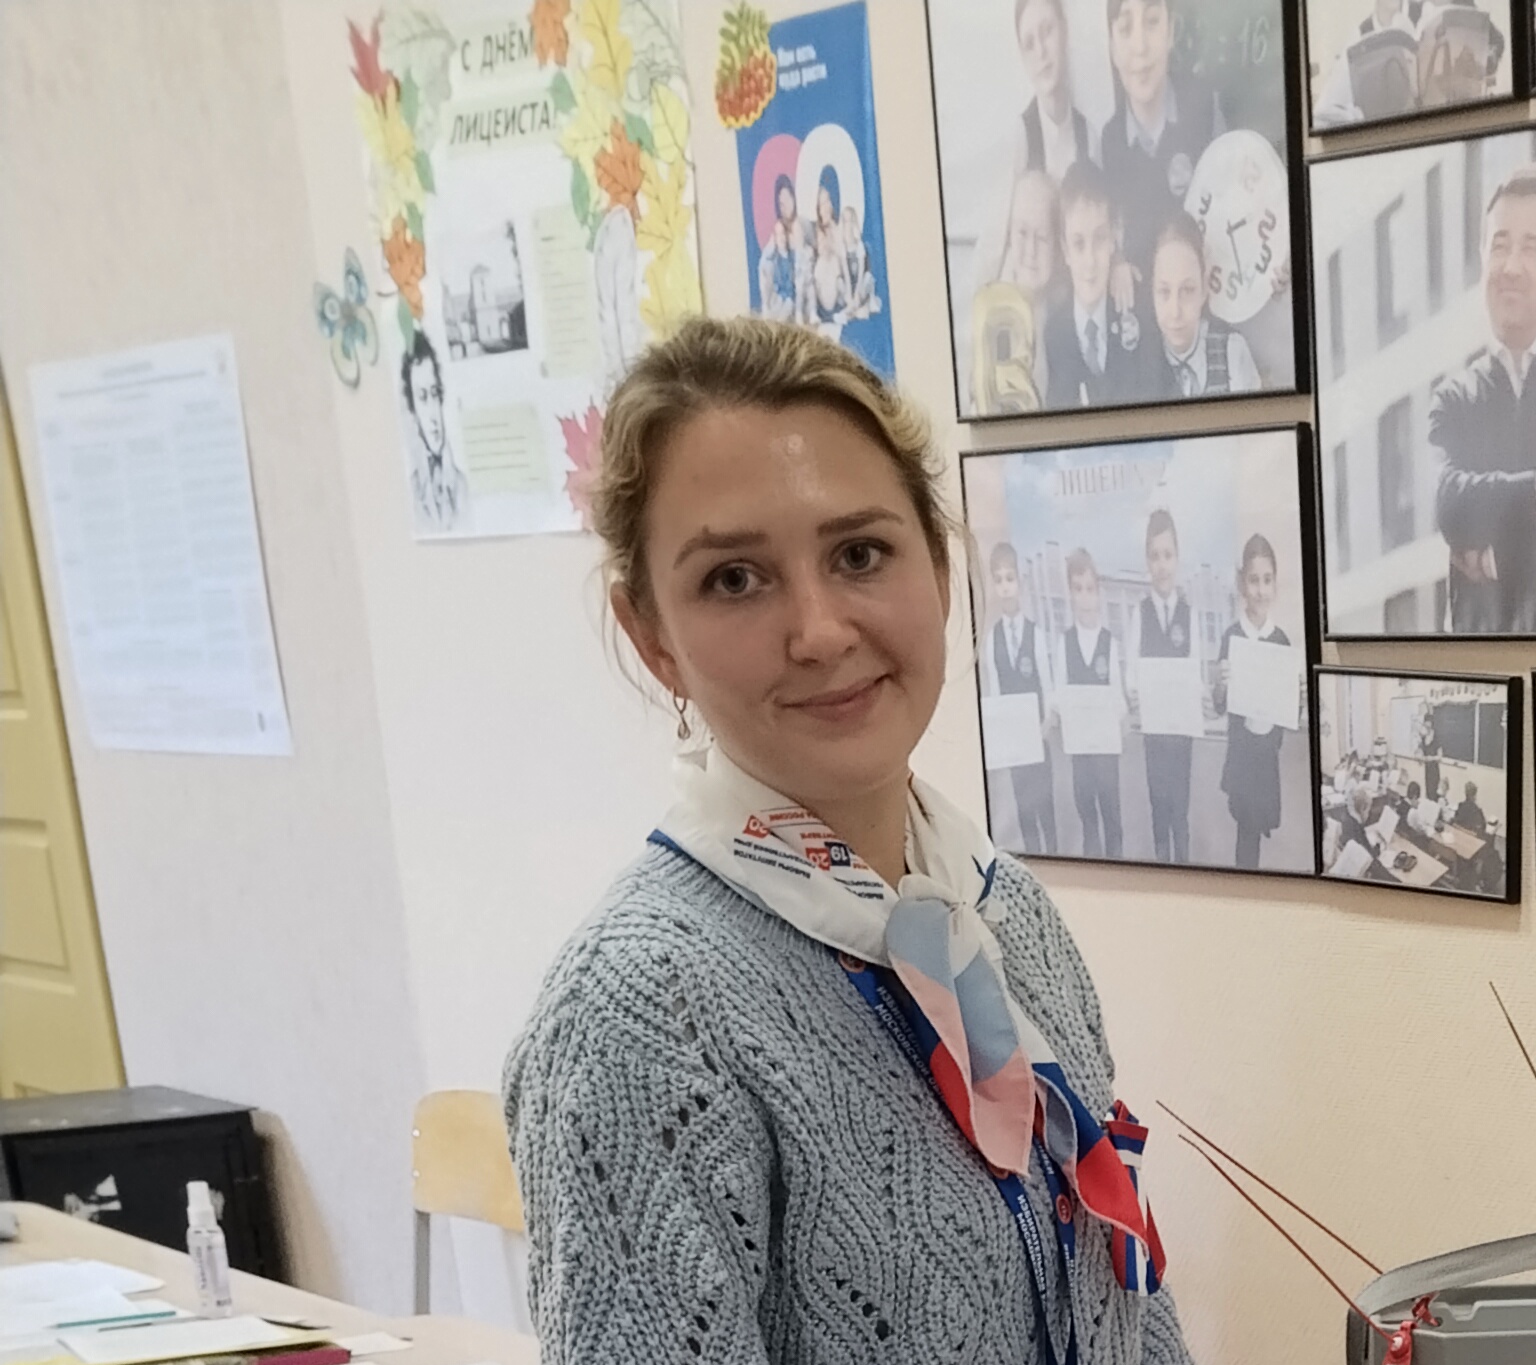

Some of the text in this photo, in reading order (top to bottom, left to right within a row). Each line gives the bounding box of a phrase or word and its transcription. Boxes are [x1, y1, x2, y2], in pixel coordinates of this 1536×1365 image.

[460, 23, 535, 75] С ДНЁМ
[831, 845, 848, 861] 19
